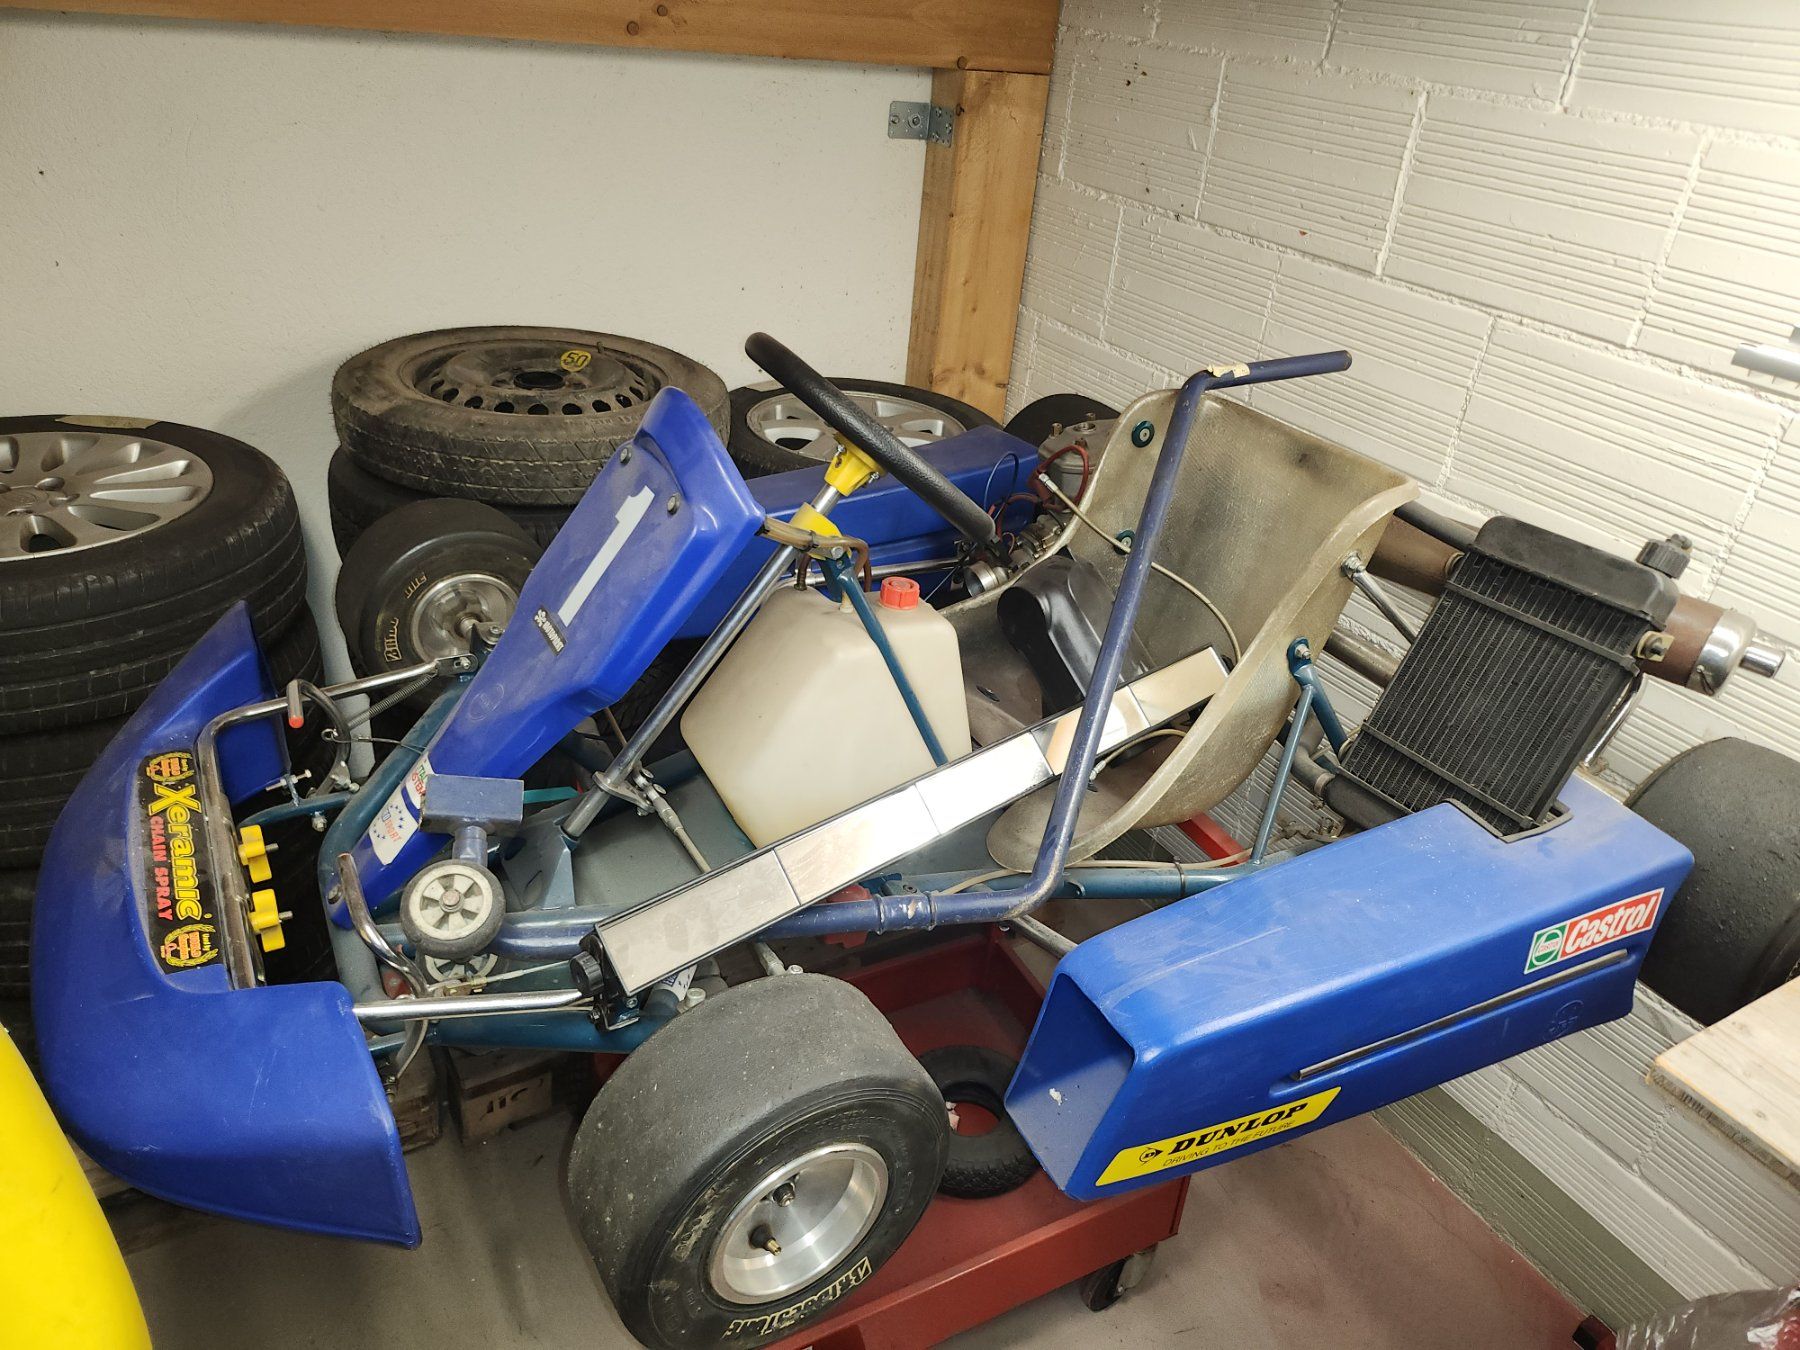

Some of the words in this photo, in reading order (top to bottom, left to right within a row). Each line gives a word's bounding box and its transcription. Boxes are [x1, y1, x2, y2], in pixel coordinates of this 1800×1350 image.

[562, 351, 590, 368] 50
[557, 484, 656, 628] 1
[149, 783, 203, 921] Xeramic
[150, 815, 167, 863] CHAIN
[153, 867, 173, 921] SPRAY
[1565, 895, 1658, 954] Castrol
[1162, 1149, 1209, 1167] DRIVING
[1212, 1142, 1229, 1152] TO
[1230, 1135, 1252, 1146] THE
[1250, 1120, 1297, 1138] FUTURE
[1167, 1102, 1309, 1155] DUNLOP
